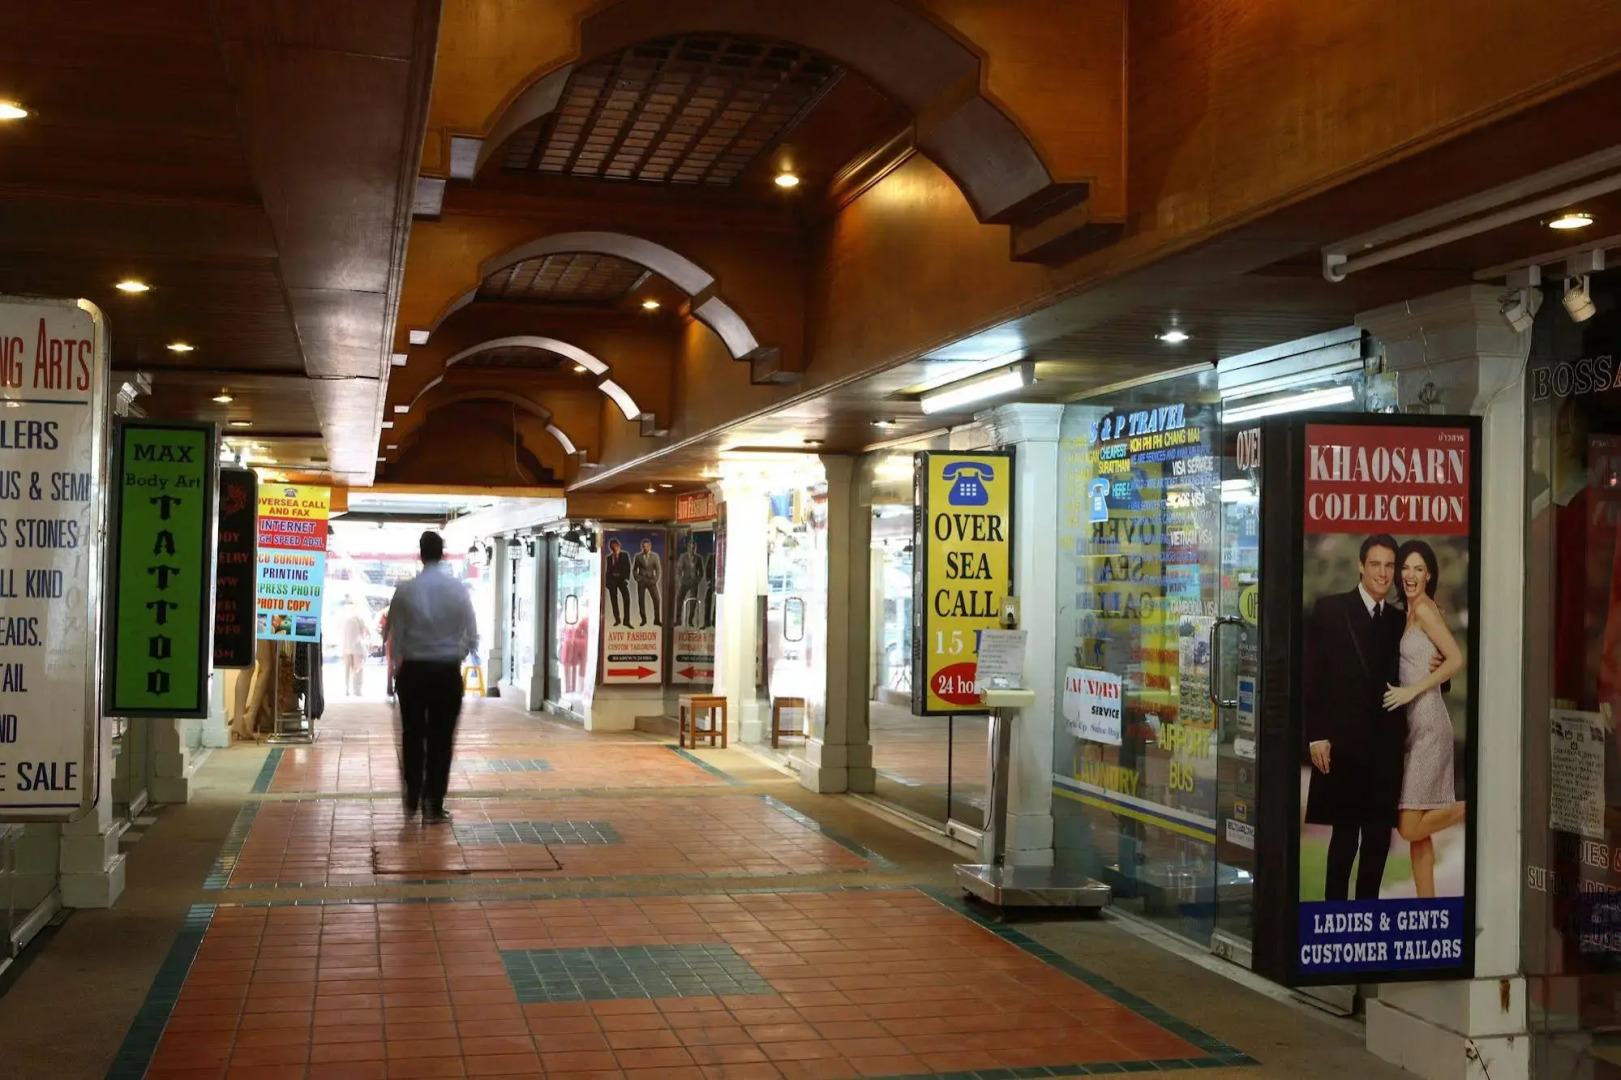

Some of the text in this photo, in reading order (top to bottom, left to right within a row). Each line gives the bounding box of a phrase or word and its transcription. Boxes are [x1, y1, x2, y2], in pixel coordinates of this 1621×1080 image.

[34, 317, 92, 391] ARTS
[1, 420, 58, 450] LERS
[1090, 421, 1099, 443] S
[1101, 417, 1112, 442] &
[1114, 415, 1126, 439] P
[1128, 402, 1186, 437] TRAVEL
[133, 444, 194, 464] MAX
[1172, 460, 1186, 476] VISA
[1308, 444, 1464, 485] KHAOSARN
[0, 470, 20, 500] US
[29, 471, 42, 500] &
[126, 474, 200, 490] Body Art
[258, 498, 326, 510] VERSEA CALL
[269, 507, 310, 518] AND FAX
[1308, 492, 1464, 524] COLLECTION
[16, 518, 77, 549] STONES
[261, 520, 316, 534] INTERNET
[934, 512, 1004, 542] OVER
[274, 536, 301, 546] SPEED
[303, 536, 324, 548] ADSL
[274, 554, 315, 567] BURNING
[946, 551, 993, 580] SEA
[26, 570, 63, 599] KIND
[262, 568, 309, 582] PRINTING
[146, 495, 182, 696] TATTOO
[290, 584, 321, 598] PHOTO
[934, 588, 998, 618] CALL
[287, 600, 312, 612] COPY
[627, 632, 657, 641] FASHION
[936, 630, 964, 655] 15
[0, 663, 28, 693] AIL
[938, 674, 954, 694] 24
[1091, 706, 1120, 719] SERVICE
[1158, 721, 1211, 758] AIRPORT
[17, 762, 78, 792] SALE
[1073, 756, 1140, 796] LAUNDRY
[1168, 762, 1194, 792] BUS
[1314, 909, 1450, 934] LADIES & GENTS
[1301, 938, 1462, 965] CUSTOMER TAILORS
